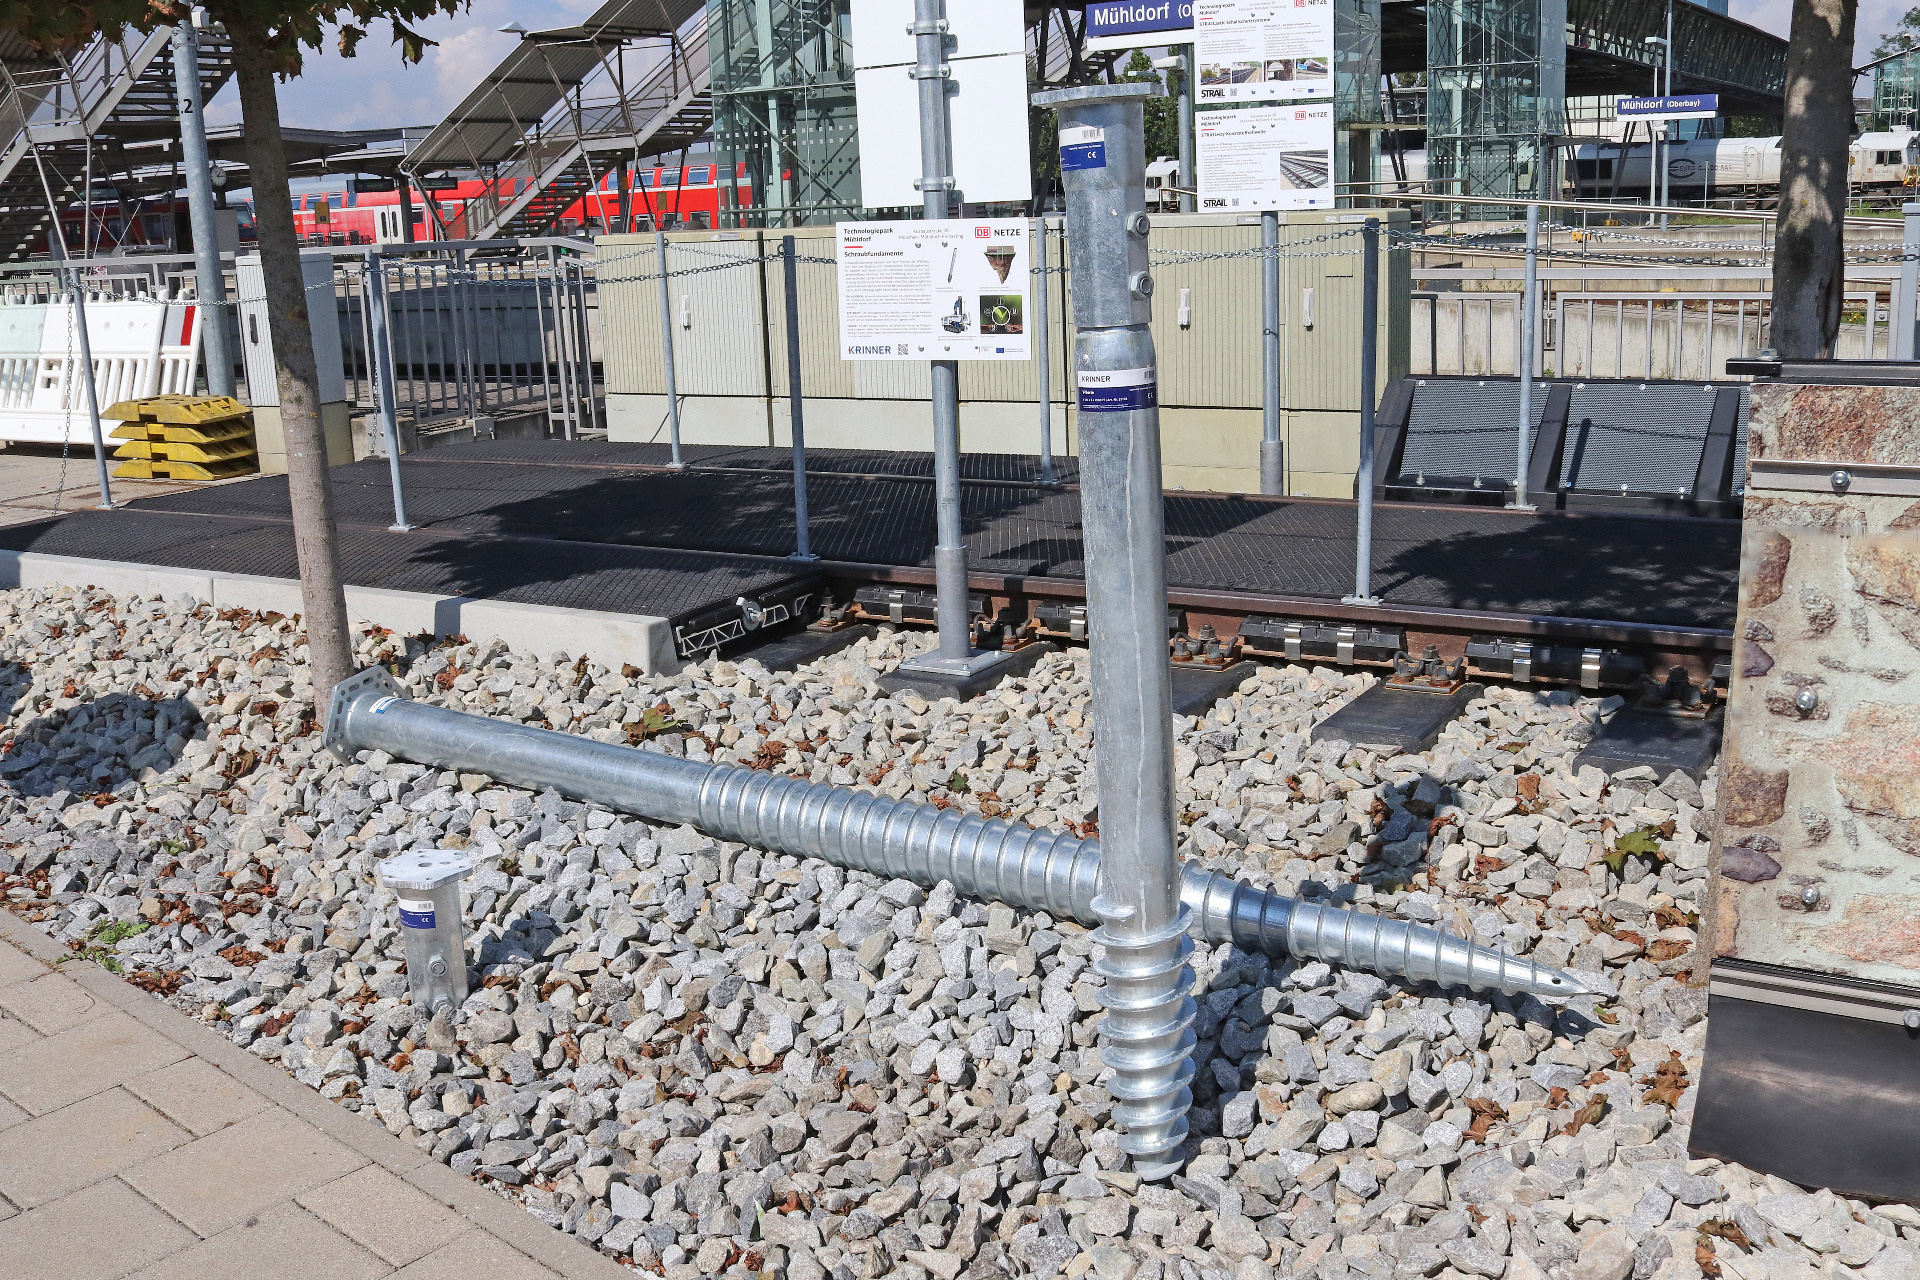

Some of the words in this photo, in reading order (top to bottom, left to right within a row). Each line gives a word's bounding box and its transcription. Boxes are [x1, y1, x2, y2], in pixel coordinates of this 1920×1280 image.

[1094, 1, 1170, 26] Mühldorf
[1178, 2, 1194, 19] (O
[1201, 89, 1226, 98] STRAIL
[1621, 99, 1664, 110] Mühldorf
[1666, 99, 1700, 109] (Oberbay)
[1203, 199, 1228, 208] STRAIL
[843, 227, 894, 236] Technologiepark
[976, 228, 989, 237] DB
[994, 228, 1021, 236] NETZE
[844, 250, 904, 258] Schraubfundamente
[848, 345, 892, 355] KRINNER
[1081, 375, 1111, 383] KRINNER
